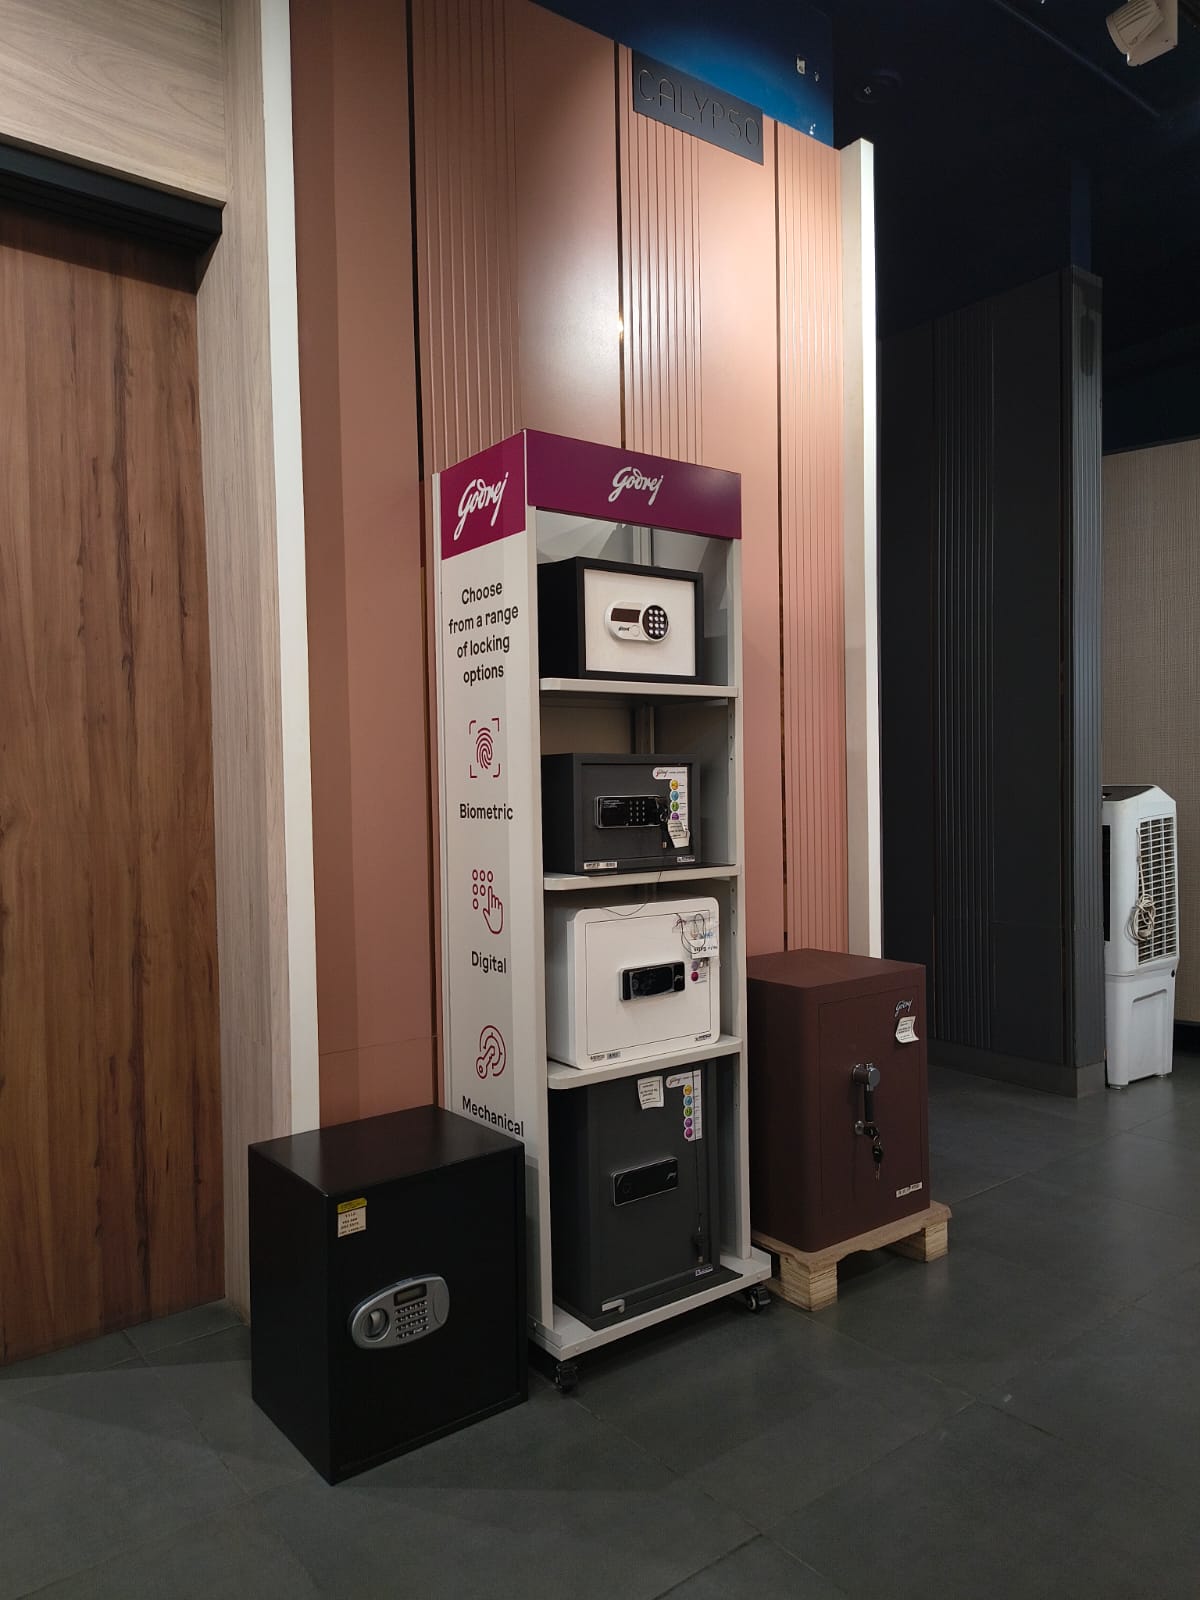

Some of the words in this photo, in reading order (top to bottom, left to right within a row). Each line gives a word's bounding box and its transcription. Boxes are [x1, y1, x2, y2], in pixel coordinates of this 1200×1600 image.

[638, 69, 760, 145] CALYPSO
[608, 466, 664, 506] Godrej
[453, 471, 509, 541] Godrej
[461, 582, 503, 605] Choose
[448, 618, 474, 635] from
[476, 615, 483, 628] a
[485, 606, 519, 625] range
[457, 641, 468, 658] of
[470, 634, 510, 656] locking
[463, 664, 504, 687] options
[459, 803, 514, 820] Biometric
[471, 950, 507, 974] Digital
[462, 1095, 524, 1137] Mechanical
